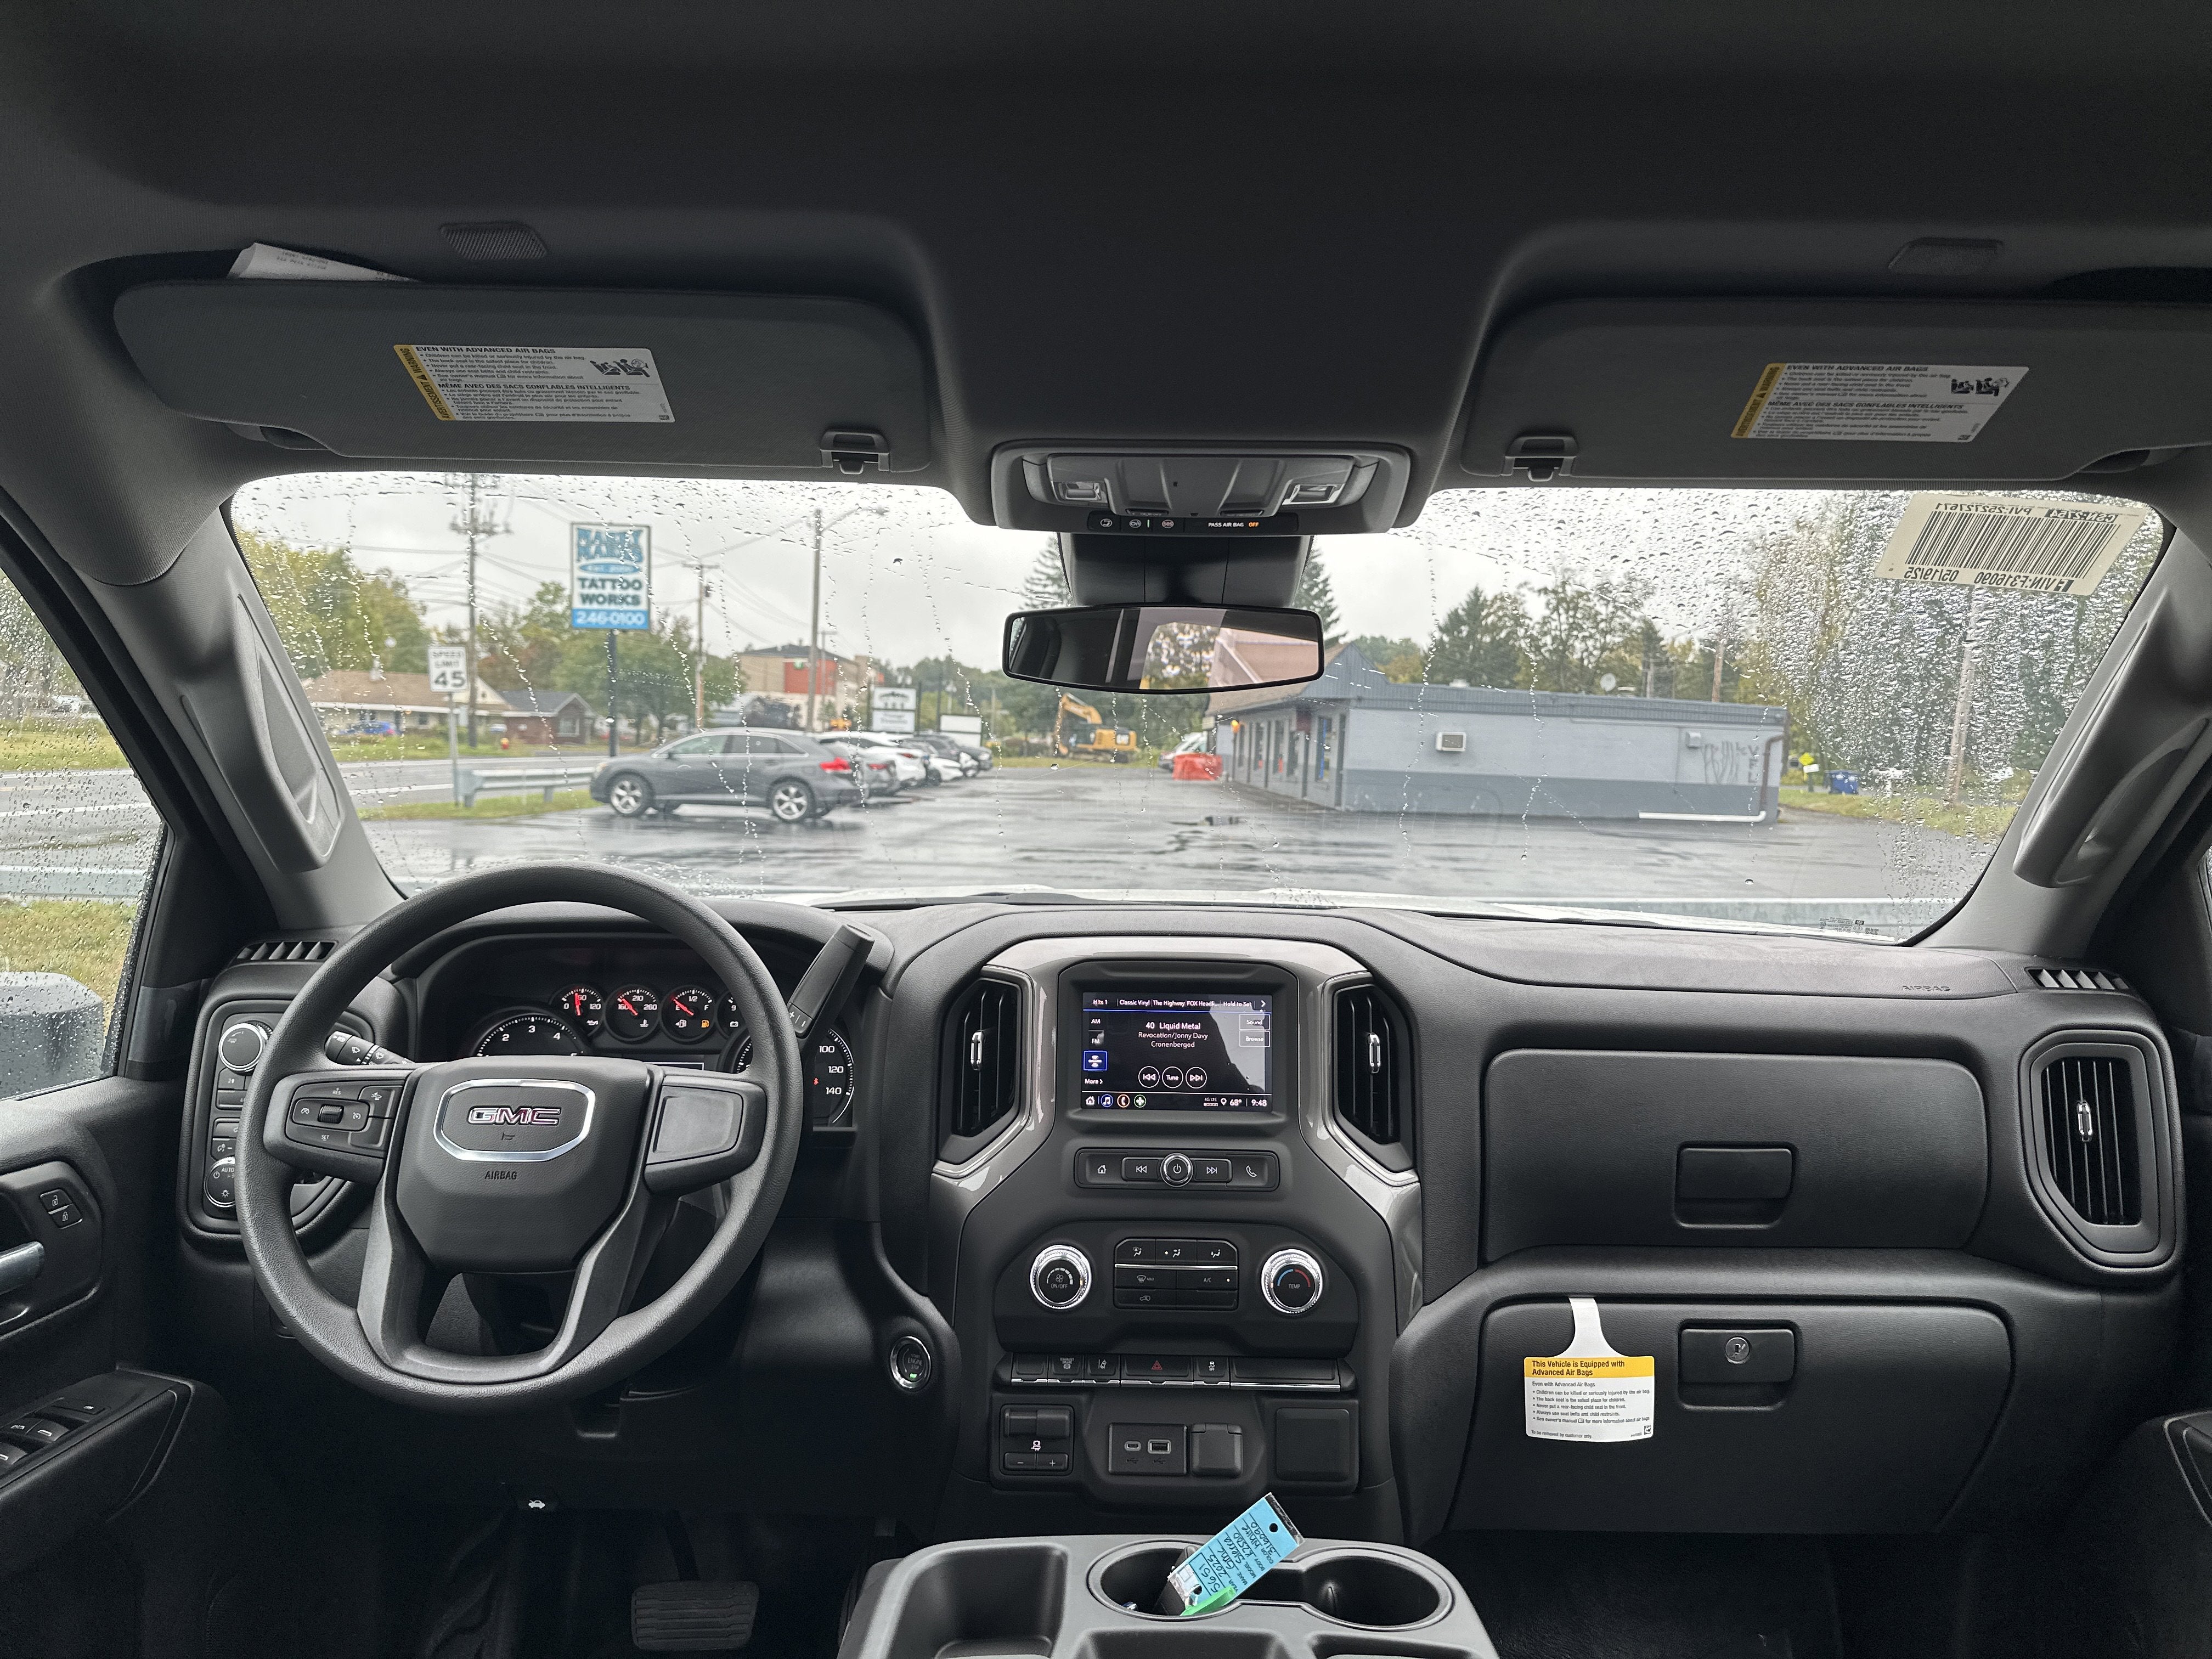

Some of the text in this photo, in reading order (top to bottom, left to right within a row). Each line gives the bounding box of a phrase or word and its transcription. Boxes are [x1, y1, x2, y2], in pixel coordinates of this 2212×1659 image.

[578, 577, 642, 590] TATTOO
[580, 593, 641, 606] WORKS
[576, 611, 645, 625] 246-0100
[434, 670, 466, 688] 45
[528, 1025, 535, 1033] 3
[1159, 1022, 1180, 1031] Liquid
[502, 1034, 510, 1042] 2
[1138, 1032, 1192, 1040] Revocation/Jonny
[467, 1105, 562, 1126] GMC
[484, 1170, 517, 1181] AIRBAG
[1251, 1522, 1276, 1555] 316090
[1224, 1537, 1242, 1564] Sierra
[1261, 1548, 1273, 1564] COLOR
[1207, 1554, 1227, 1577] 2025
[1244, 1561, 1256, 1578] MODEL
[1254, 1558, 1265, 1571] BODY
[1199, 1564, 1220, 1593] 5651
[1237, 1571, 1248, 1585] MAKE
